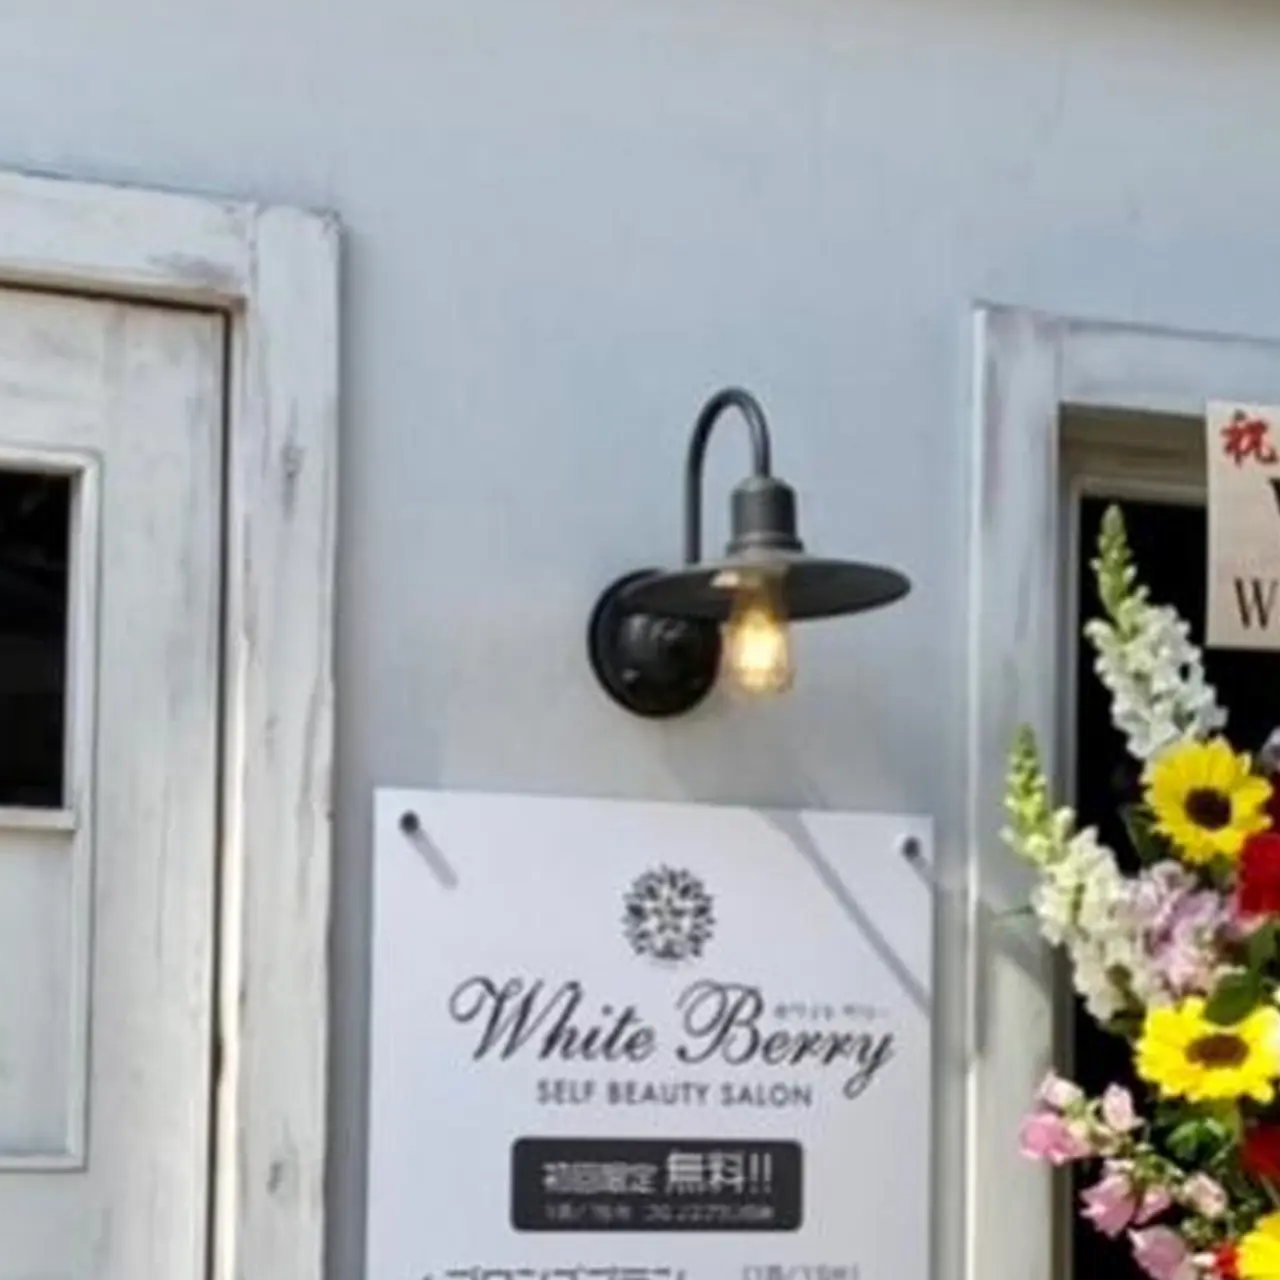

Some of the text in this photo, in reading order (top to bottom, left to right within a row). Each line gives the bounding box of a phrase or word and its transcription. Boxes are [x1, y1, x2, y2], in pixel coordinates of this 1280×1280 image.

[449, 975, 896, 1101] White Berry
[536, 1078, 813, 1109] SELF BEAUTY SALON
